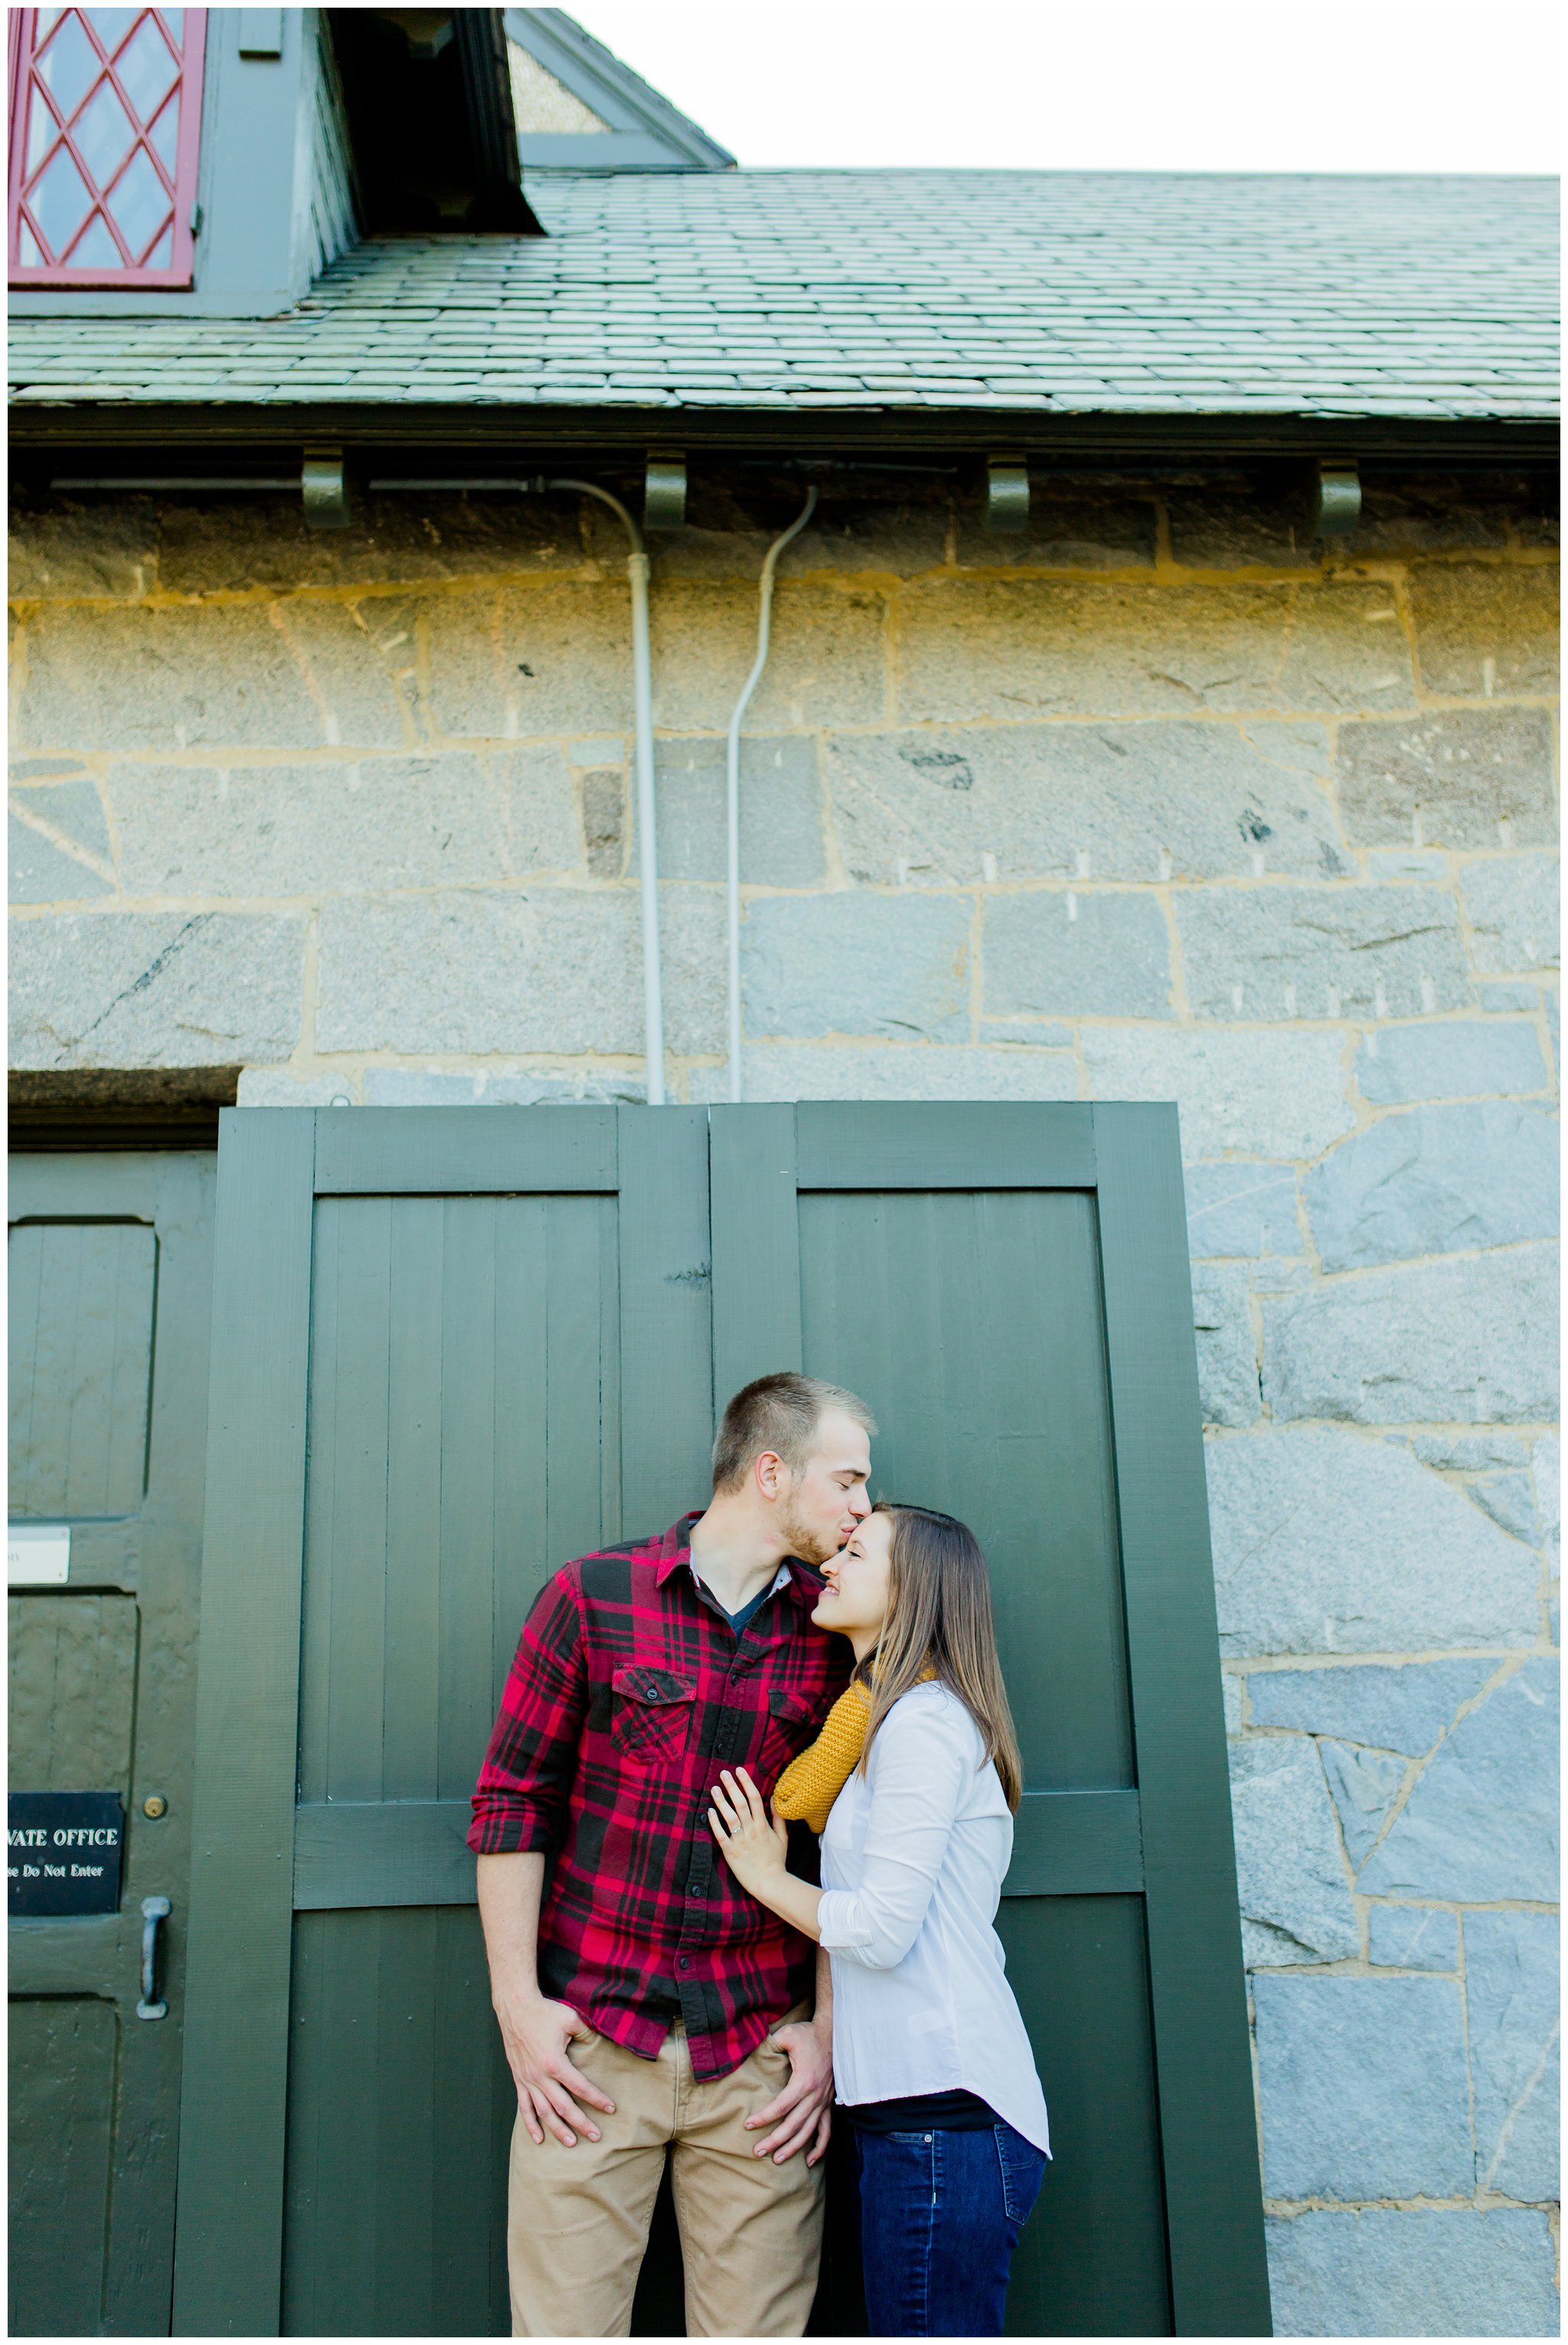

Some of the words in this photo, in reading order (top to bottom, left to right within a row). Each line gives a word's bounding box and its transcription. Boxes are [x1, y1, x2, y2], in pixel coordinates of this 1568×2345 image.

[53, 1828, 118, 1846] OFFICE
[23, 1864, 40, 1877] Do
[44, 1864, 66, 1877] Not
[70, 1863, 103, 1877] Enter
